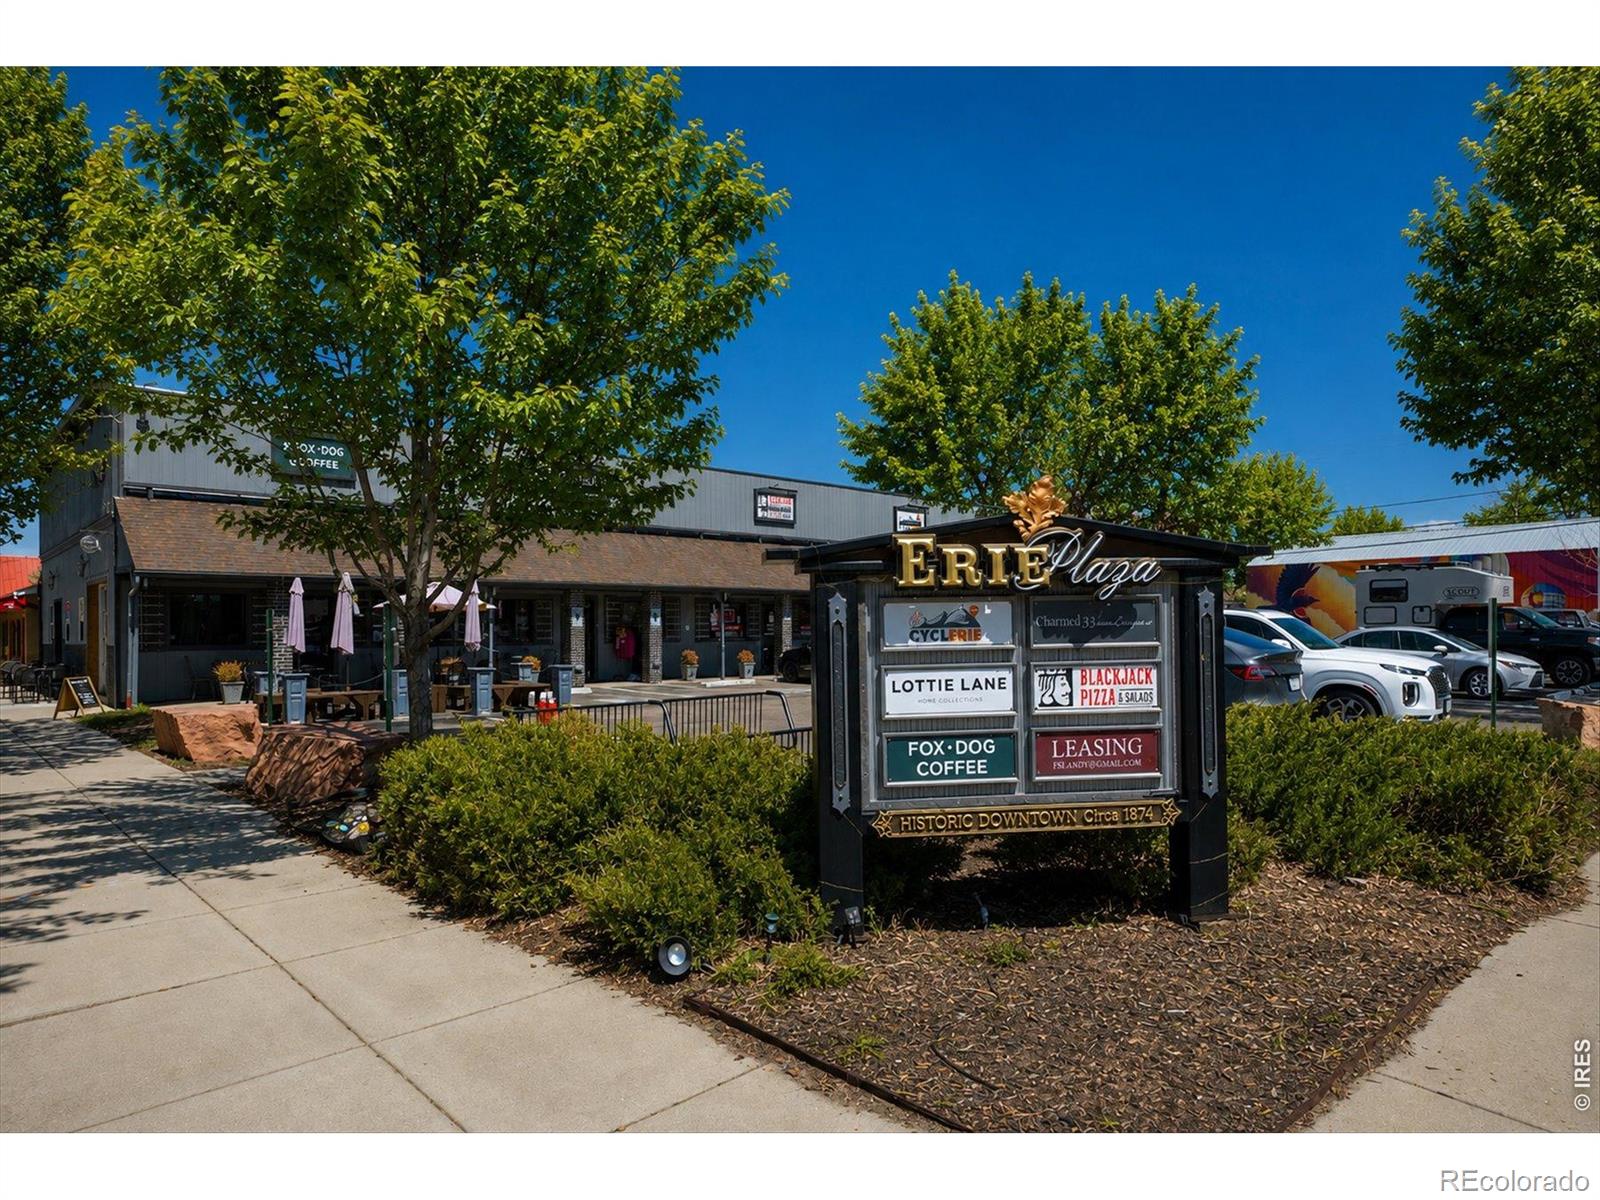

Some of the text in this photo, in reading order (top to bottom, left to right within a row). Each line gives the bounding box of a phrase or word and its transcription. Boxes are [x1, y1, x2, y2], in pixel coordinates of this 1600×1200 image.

[1014, 529, 1161, 600] Plaza
[1035, 614, 1081, 627] Charmed
[1082, 617, 1096, 629] 33
[909, 629, 982, 642] CYCLERIE
[891, 677, 1007, 693] LOTTIE LANE
[1080, 667, 1153, 686] BLACKJACK
[1081, 688, 1115, 706] PIZZA
[1125, 691, 1154, 703] SALADS
[1051, 737, 1142, 758] LEASING
[916, 759, 988, 776] COFFEE
[900, 805, 1154, 832] HISTORIC DOWNTOWN Circa 1874
